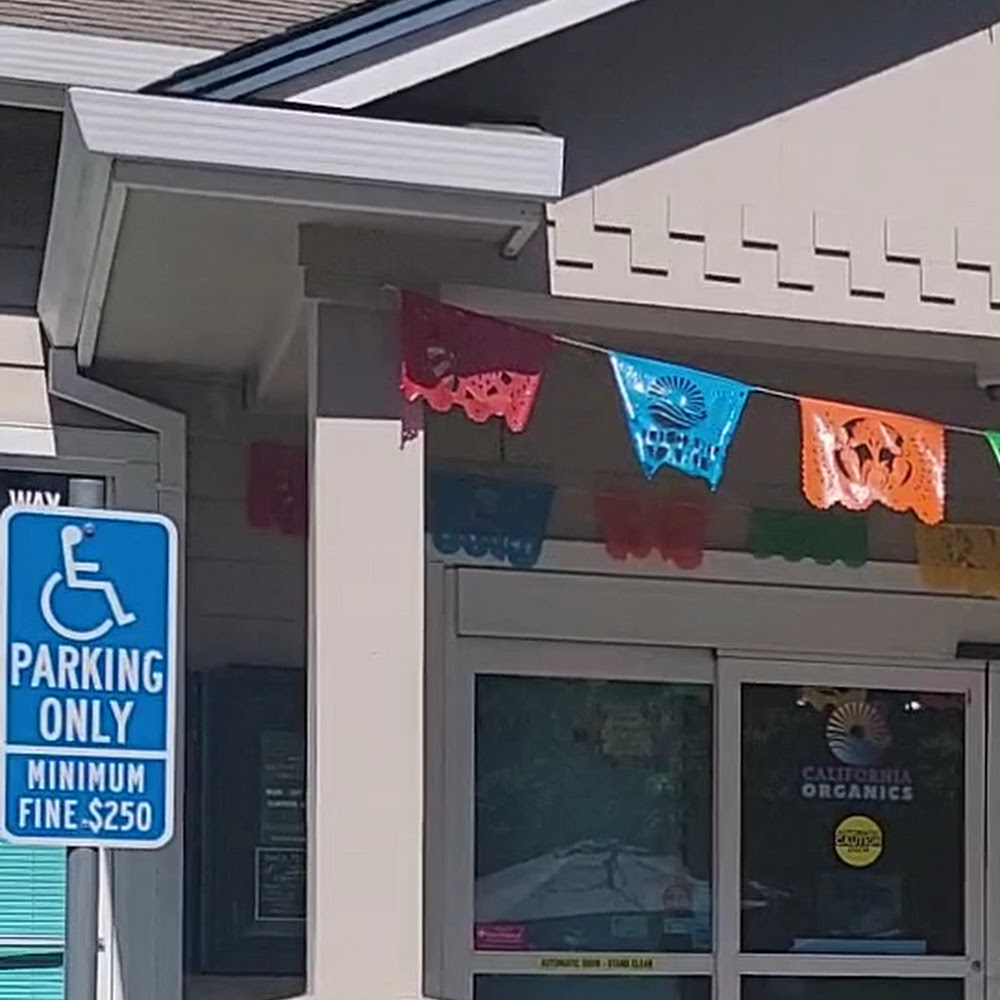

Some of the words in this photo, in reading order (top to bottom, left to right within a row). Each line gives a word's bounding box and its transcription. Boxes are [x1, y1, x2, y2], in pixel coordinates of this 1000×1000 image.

[11, 642, 164, 693] PARKING
[40, 697, 134, 744] ONLY
[28, 759, 145, 793] MINIMUM
[802, 766, 912, 783] CALIFORNIA
[802, 783, 913, 800] ORGANICS
[19, 798, 78, 829] FINE
[89, 799, 152, 833] $250
